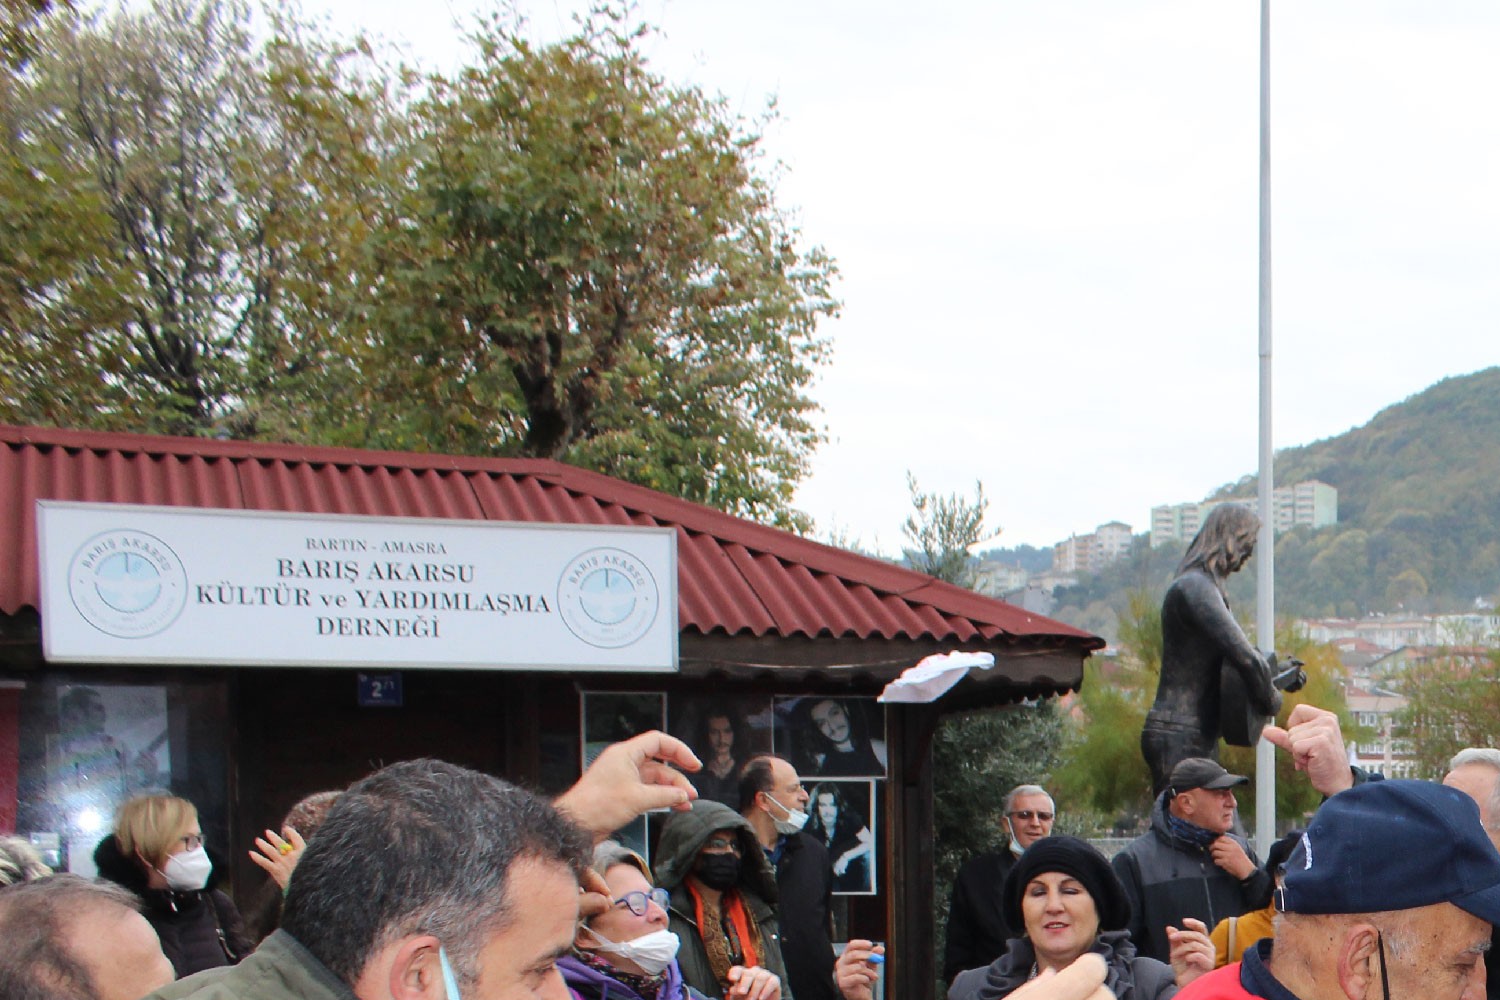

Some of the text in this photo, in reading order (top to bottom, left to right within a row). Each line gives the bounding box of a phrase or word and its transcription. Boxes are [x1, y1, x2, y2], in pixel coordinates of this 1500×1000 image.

[306, 537, 367, 551] BARTIN
[381, 540, 448, 554] AMASRA
[276, 557, 475, 584] BARIŞ AKARSU
[195, 580, 551, 615] KÜLTÜR ve YARDIMLAŞMA
[315, 615, 441, 638] DERNEĞİ
